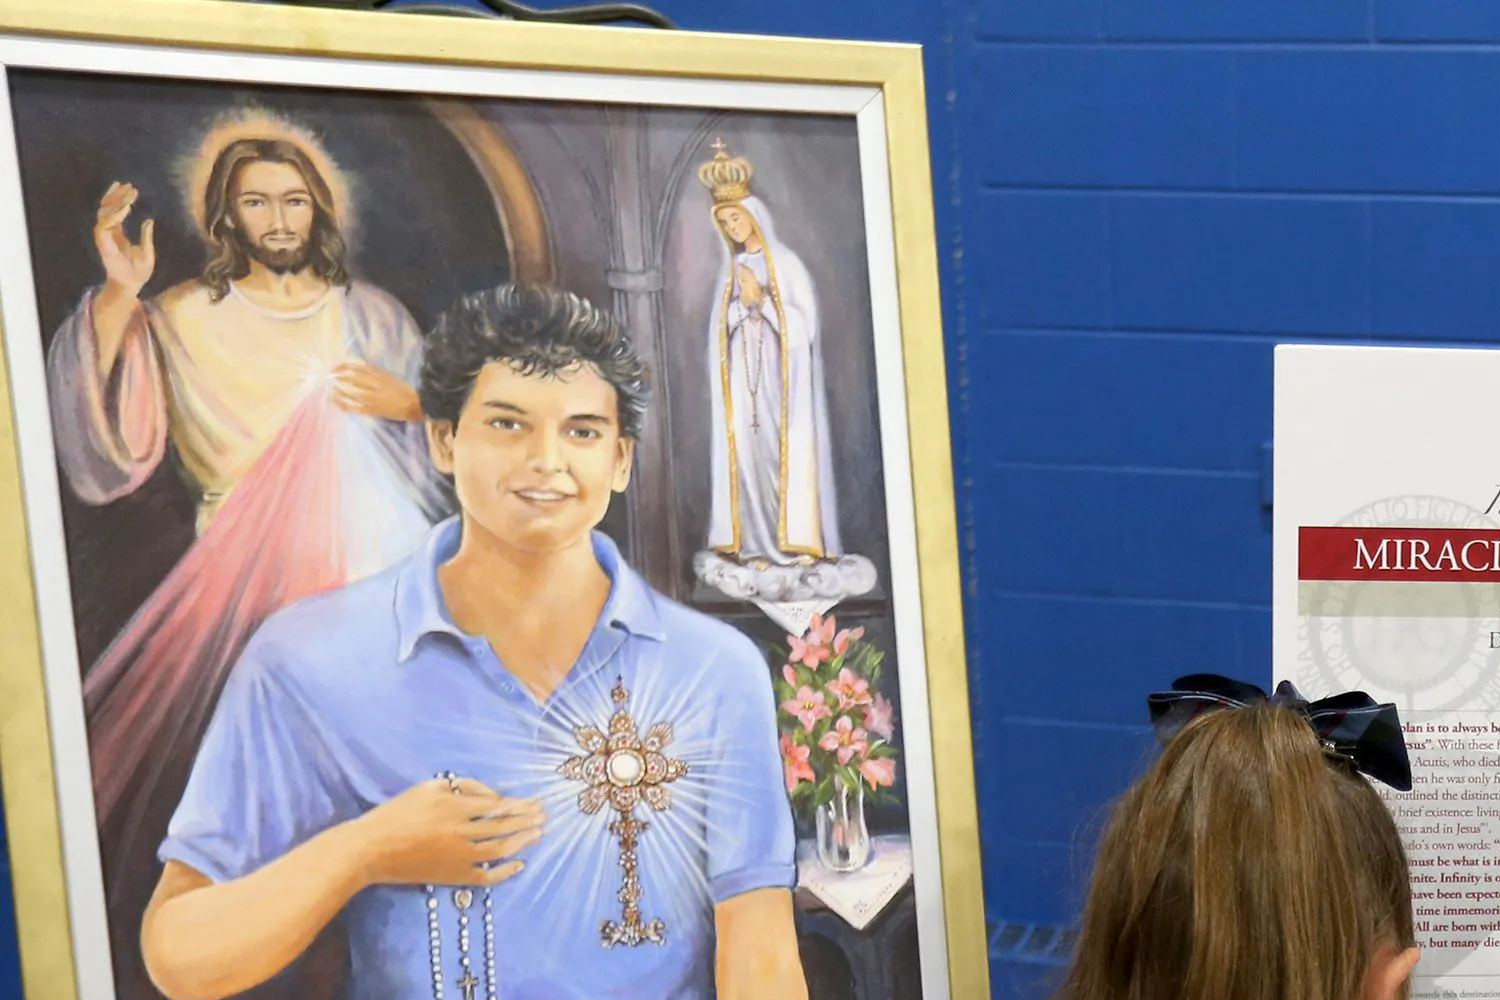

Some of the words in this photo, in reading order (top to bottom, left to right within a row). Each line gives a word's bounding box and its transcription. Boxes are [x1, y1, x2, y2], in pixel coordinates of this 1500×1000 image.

[1426, 723, 1434, 732] is
[1438, 725, 1448, 733] to
[1452, 721, 1488, 736] always
[1437, 739, 1464, 750] With
[1468, 739, 1494, 750] these
[1415, 756, 1449, 769] Acutis,
[1453, 756, 1476, 767] who
[1478, 755, 1500, 767] died
[1430, 772, 1444, 783] he
[1446, 776, 1465, 787] was
[1468, 772, 1491, 786] only
[1396, 788, 1438, 800] outlined
[1442, 789, 1457, 800] the
[1399, 805, 1423, 817] brief
[1425, 806, 1473, 817] existence:
[1420, 822, 1440, 834] and
[1443, 823, 1453, 834] in
[1457, 838, 1490, 851] words:
[1437, 856, 1450, 866] be
[1453, 856, 1479, 866] what
[1482, 856, 1490, 866] is
[1440, 872, 1481, 885] Infinity
[1484, 873, 1492, 882] is
[1437, 888, 1461, 899] been
[1416, 906, 1440, 915] time
[1452, 920, 1476, 931] born
[1429, 937, 1447, 947] but
[1451, 940, 1480, 950] many
[1484, 936, 1500, 947] die
